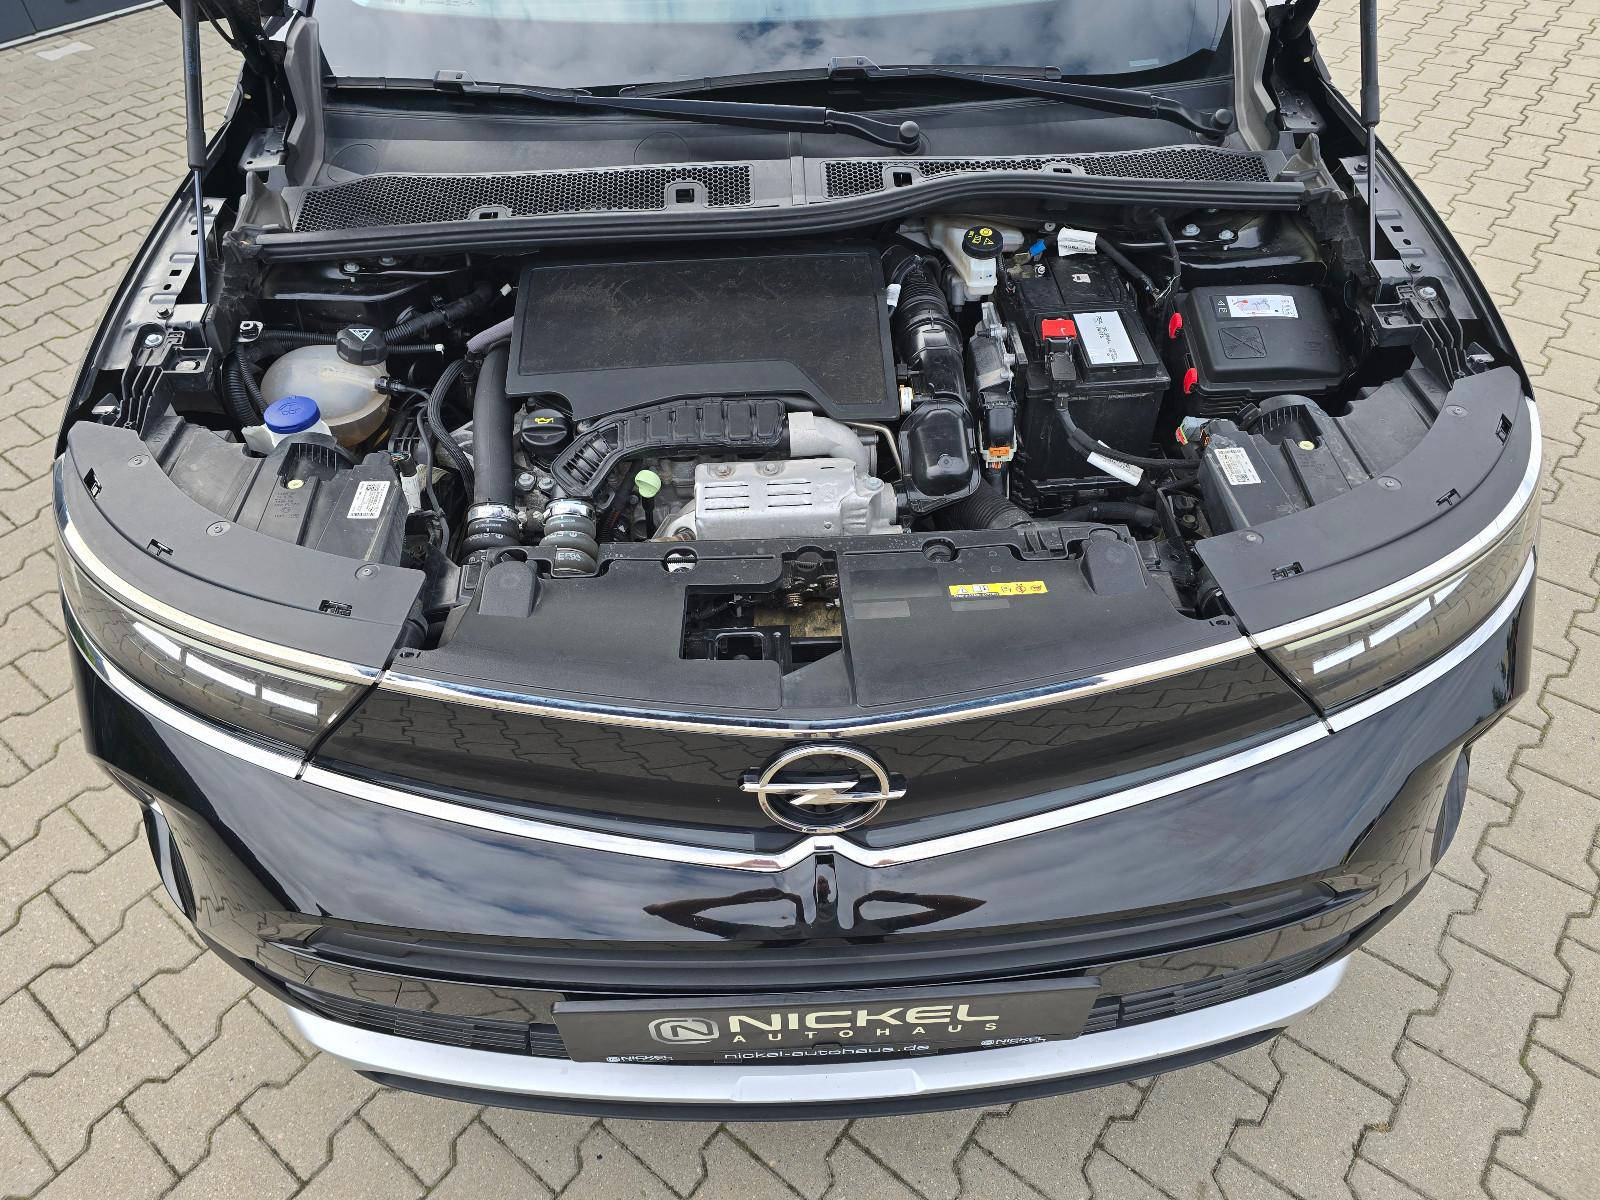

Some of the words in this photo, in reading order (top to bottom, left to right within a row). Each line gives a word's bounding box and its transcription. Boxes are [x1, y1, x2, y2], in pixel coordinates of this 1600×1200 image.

[729, 1004, 1000, 1033] NICKEL
[733, 1022, 997, 1043] AUTOHAUS
[995, 1036, 1047, 1045] NICKEL
[724, 1044, 930, 1060] nickel-autohaus.de
